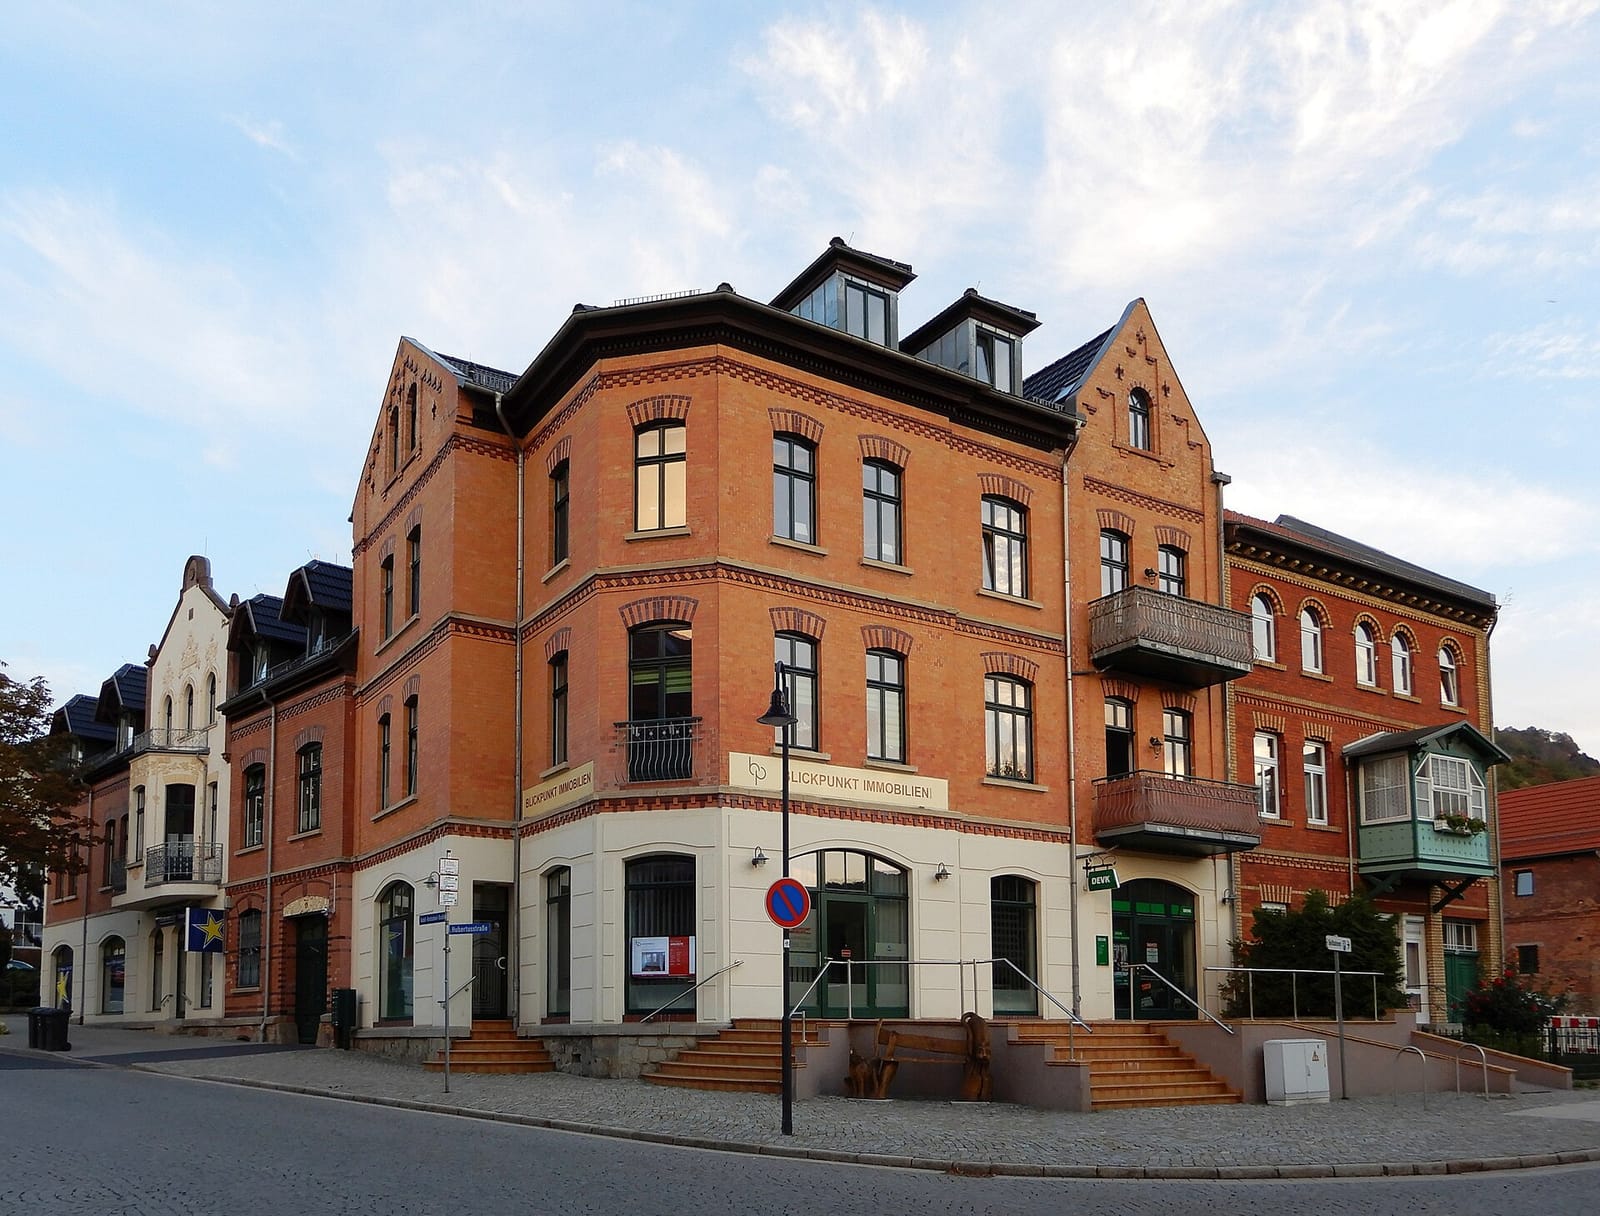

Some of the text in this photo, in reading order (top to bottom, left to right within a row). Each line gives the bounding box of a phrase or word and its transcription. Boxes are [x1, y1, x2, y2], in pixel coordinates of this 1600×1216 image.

[525, 772, 592, 808] BLICKPUNKT IMMOBILIEN
[787, 770, 929, 799] LICKPUNKT IMMOBILIEN
[1091, 875, 1111, 885] DEVK
